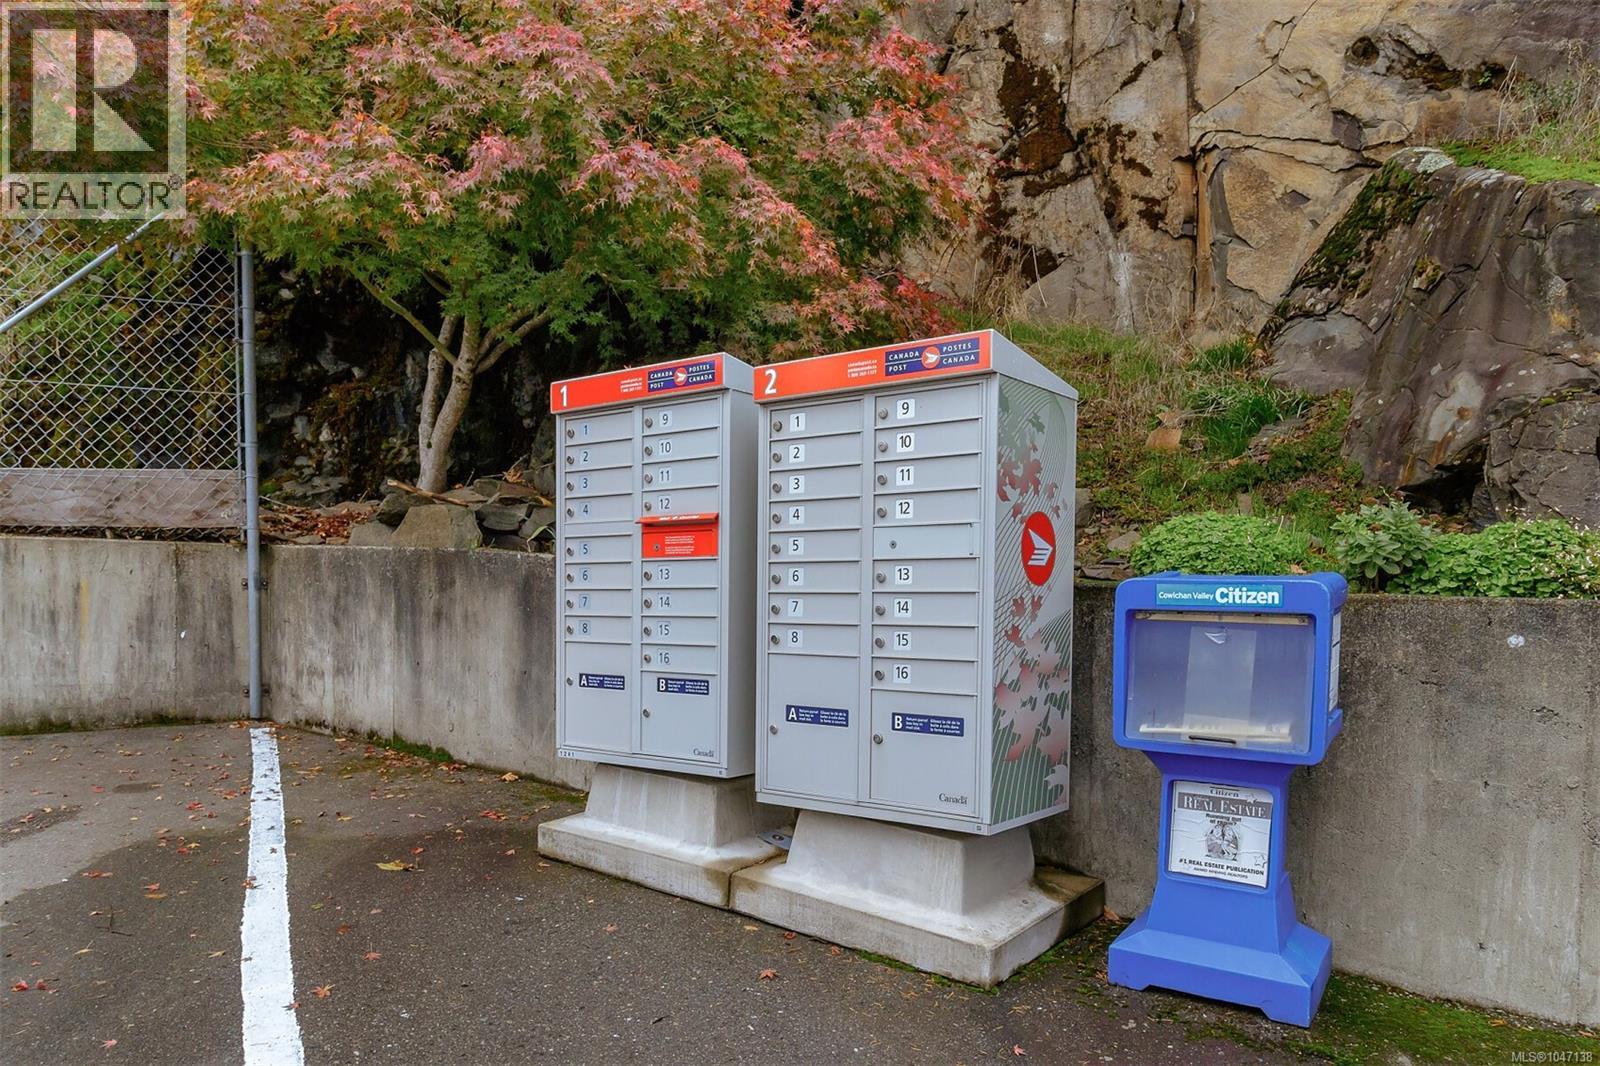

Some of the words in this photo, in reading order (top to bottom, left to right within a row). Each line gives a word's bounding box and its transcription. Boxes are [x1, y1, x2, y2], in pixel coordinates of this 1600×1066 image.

[942, 342, 972, 352] POSTES
[889, 351, 920, 360] CANADA
[942, 354, 975, 365] CANADA
[688, 364, 710, 373] POSTES
[650, 371, 673, 379] CANADA
[688, 374, 713, 382] CANADA
[764, 368, 777, 395] 2
[560, 385, 568, 407] 1
[902, 402, 909, 415] 9
[662, 413, 669, 425] 9
[794, 416, 800, 427] 1
[584, 425, 588, 435] 1
[660, 442, 671, 453] 10
[900, 436, 912, 448] 10
[583, 451, 588, 462] 2
[793, 447, 800, 459] 2
[660, 470, 670, 482] 11
[900, 469, 911, 481] 11
[582, 478, 588, 488] 3
[793, 477, 800, 490] 3
[583, 504, 589, 515] 4
[660, 498, 670, 509] 12
[899, 502, 910, 515] 12
[793, 508, 800, 520] 4
[583, 544, 588, 554] 5
[792, 539, 799, 551] 5
[582, 570, 588, 581] 6
[659, 569, 670, 580] 13
[792, 570, 799, 582] 6
[897, 568, 910, 581] 13
[582, 596, 588, 607] 7
[1159, 591, 1192, 599] Cowichan
[1193, 592, 1214, 601] Valley
[1215, 587, 1279, 604] Citizen
[659, 597, 670, 607] 14
[792, 601, 799, 613] 7
[897, 601, 909, 613] 14
[582, 623, 588, 633] 8
[659, 625, 670, 636] 15
[791, 632, 798, 643] 8
[896, 634, 908, 646] 15
[659, 652, 670, 664] 16
[896, 666, 908, 679] 16
[580, 675, 587, 686] A
[659, 679, 665, 691] B
[788, 707, 797, 720] A
[894, 715, 902, 729] B
[1210, 788, 1239, 797] Citizen
[939, 793, 967, 805] Canada
[1183, 796, 1217, 812] REAL
[1220, 800, 1267, 818] ESTATE
[1189, 859, 1203, 867] REAL
[1204, 862, 1225, 870] ESTATE
[1226, 865, 1264, 876] PUBLICATION
